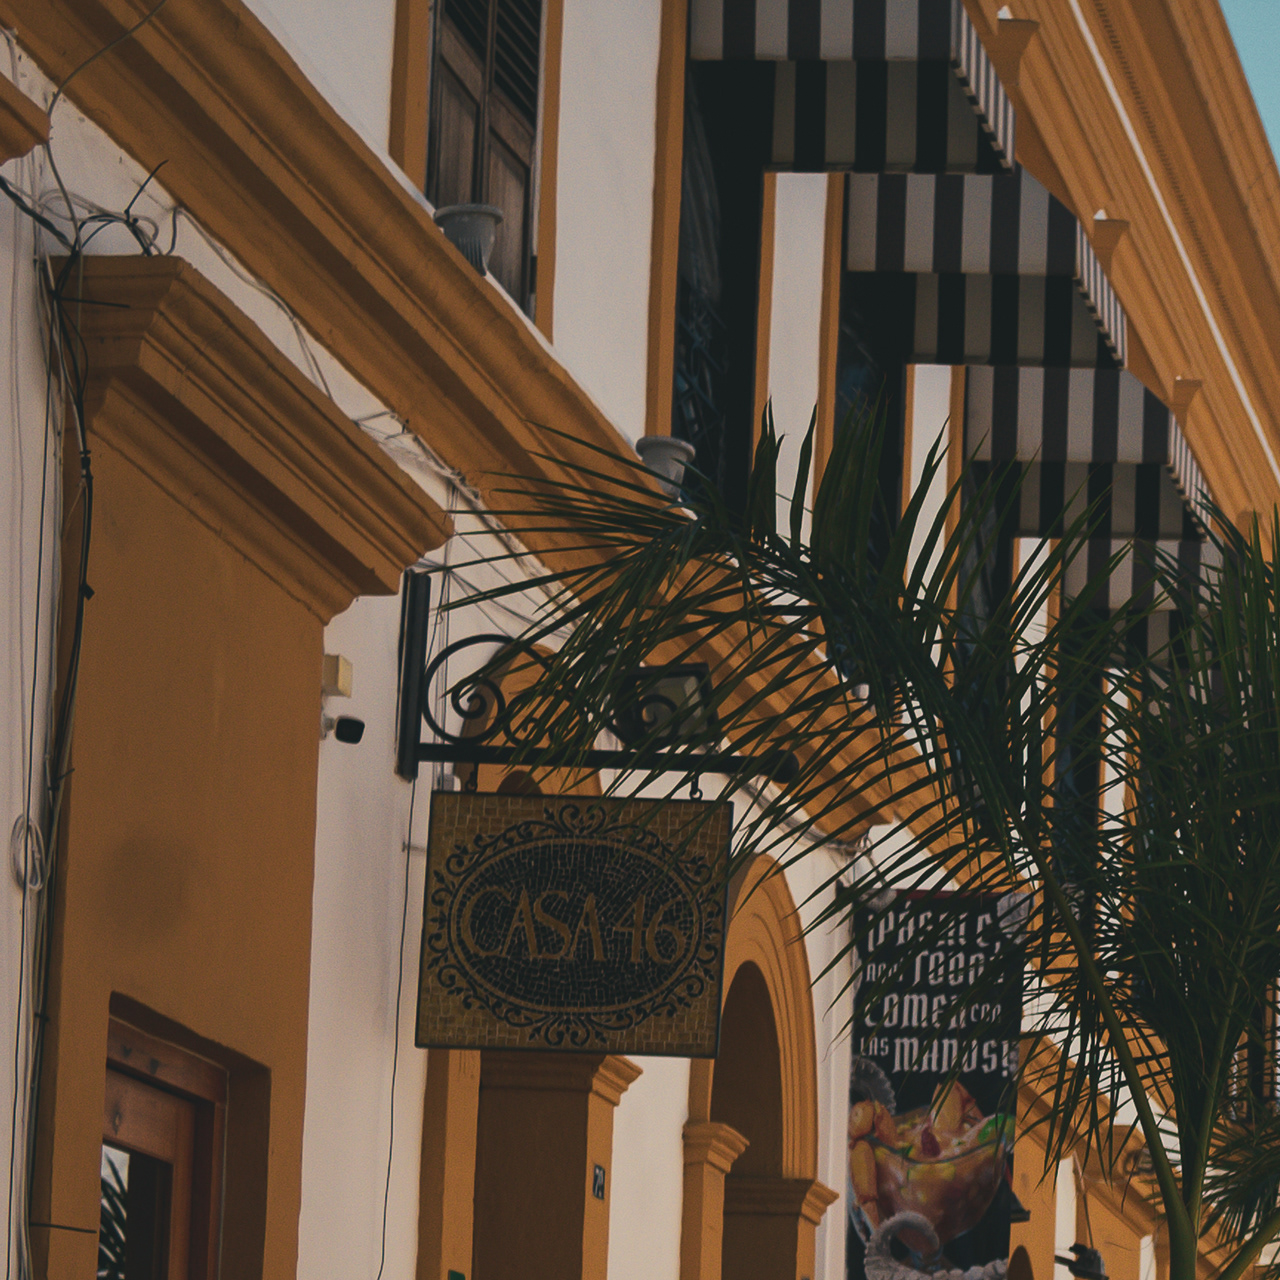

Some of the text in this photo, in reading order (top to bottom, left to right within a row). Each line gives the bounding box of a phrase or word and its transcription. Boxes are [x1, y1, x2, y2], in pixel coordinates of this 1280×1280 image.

[460, 885, 685, 966] CASA 46
[865, 993, 966, 1029] COMEN
[861, 1036, 1009, 1077] LAS MANOS!
